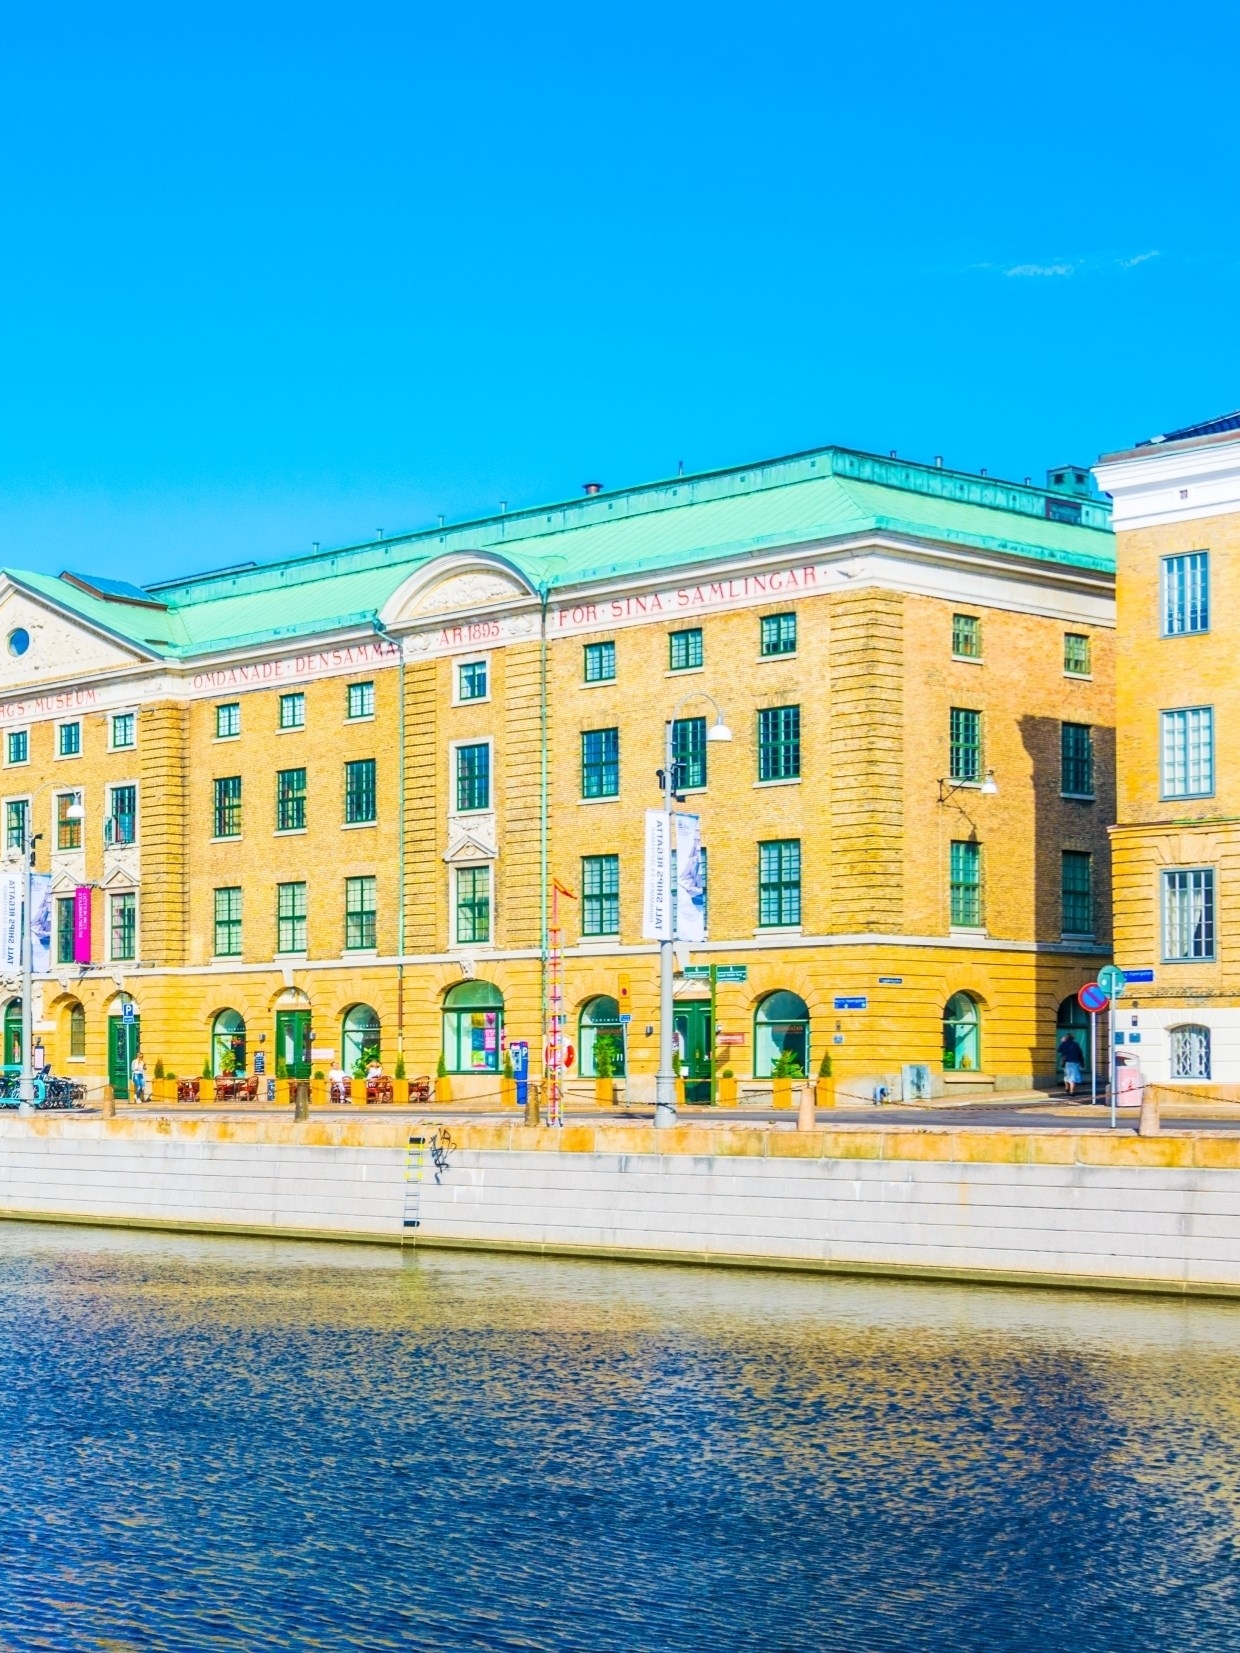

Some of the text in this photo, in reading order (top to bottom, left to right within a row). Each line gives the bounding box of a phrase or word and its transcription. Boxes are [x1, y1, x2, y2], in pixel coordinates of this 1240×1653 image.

[559, 565, 817, 627] FÖR SINA SAMLINGAR
[468, 619, 500, 641] 1895
[193, 641, 397, 689] OMDANADE DENSAMMA
[35, 688, 96, 713] MUSEUM
[126, 1005, 132, 1016] P
